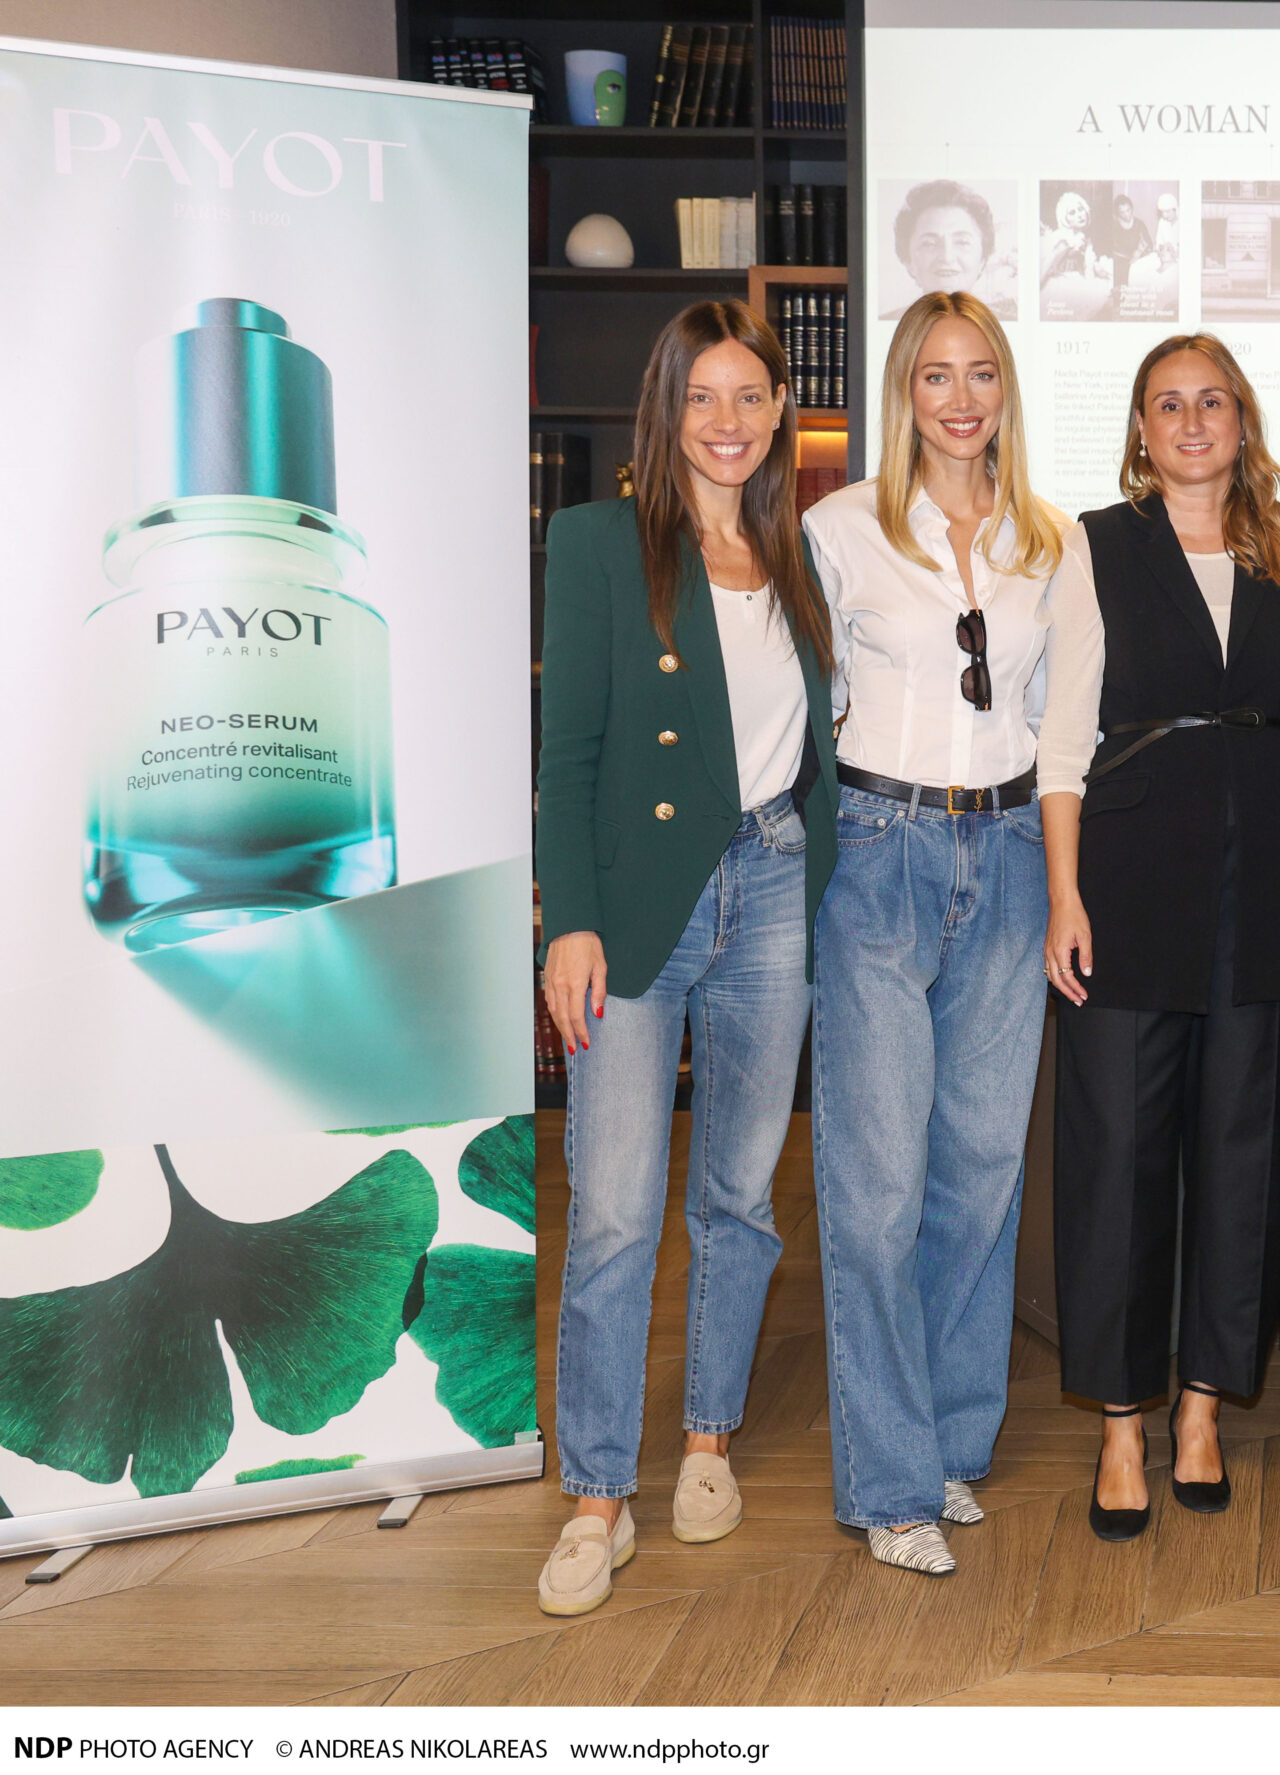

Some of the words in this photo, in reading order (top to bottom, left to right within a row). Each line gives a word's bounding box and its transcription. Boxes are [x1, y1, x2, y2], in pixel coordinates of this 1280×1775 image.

[1077, 104, 1102, 134] A
[1117, 104, 1270, 134] WOMAN
[52, 107, 407, 202] PAYOT
[1056, 341, 1090, 355] 1917
[1225, 342, 1252, 356] 920
[157, 607, 331, 646] PAYOT
[206, 646, 279, 657] PARIS
[161, 714, 318, 734] NEO-SERUM
[141, 742, 238, 766] Concentré
[242, 742, 338, 764] revitalisant
[127, 764, 243, 792] Rejuvenating
[248, 764, 353, 787] concentrate
